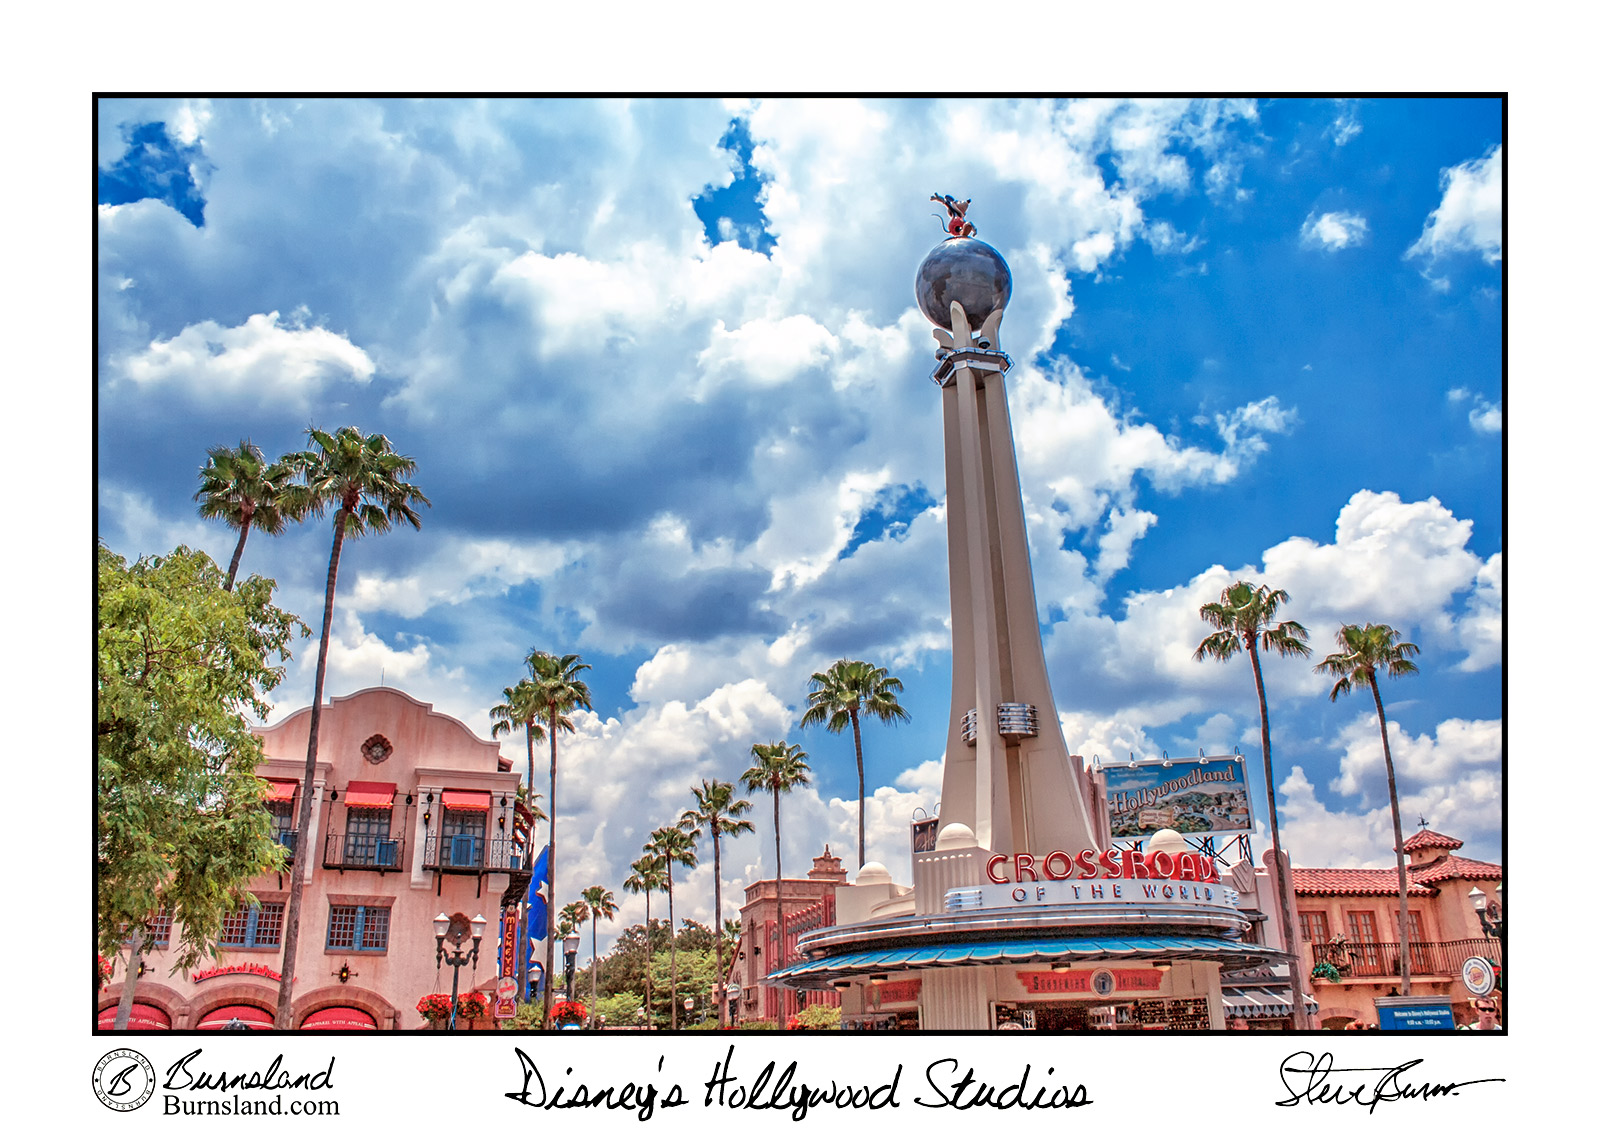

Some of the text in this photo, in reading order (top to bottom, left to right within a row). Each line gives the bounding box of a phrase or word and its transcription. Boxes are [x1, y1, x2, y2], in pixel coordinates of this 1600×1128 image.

[1109, 764, 1236, 815] Hollywoodland
[1011, 884, 1215, 901] OF THE WORLD
[236, 962, 247, 973] of
